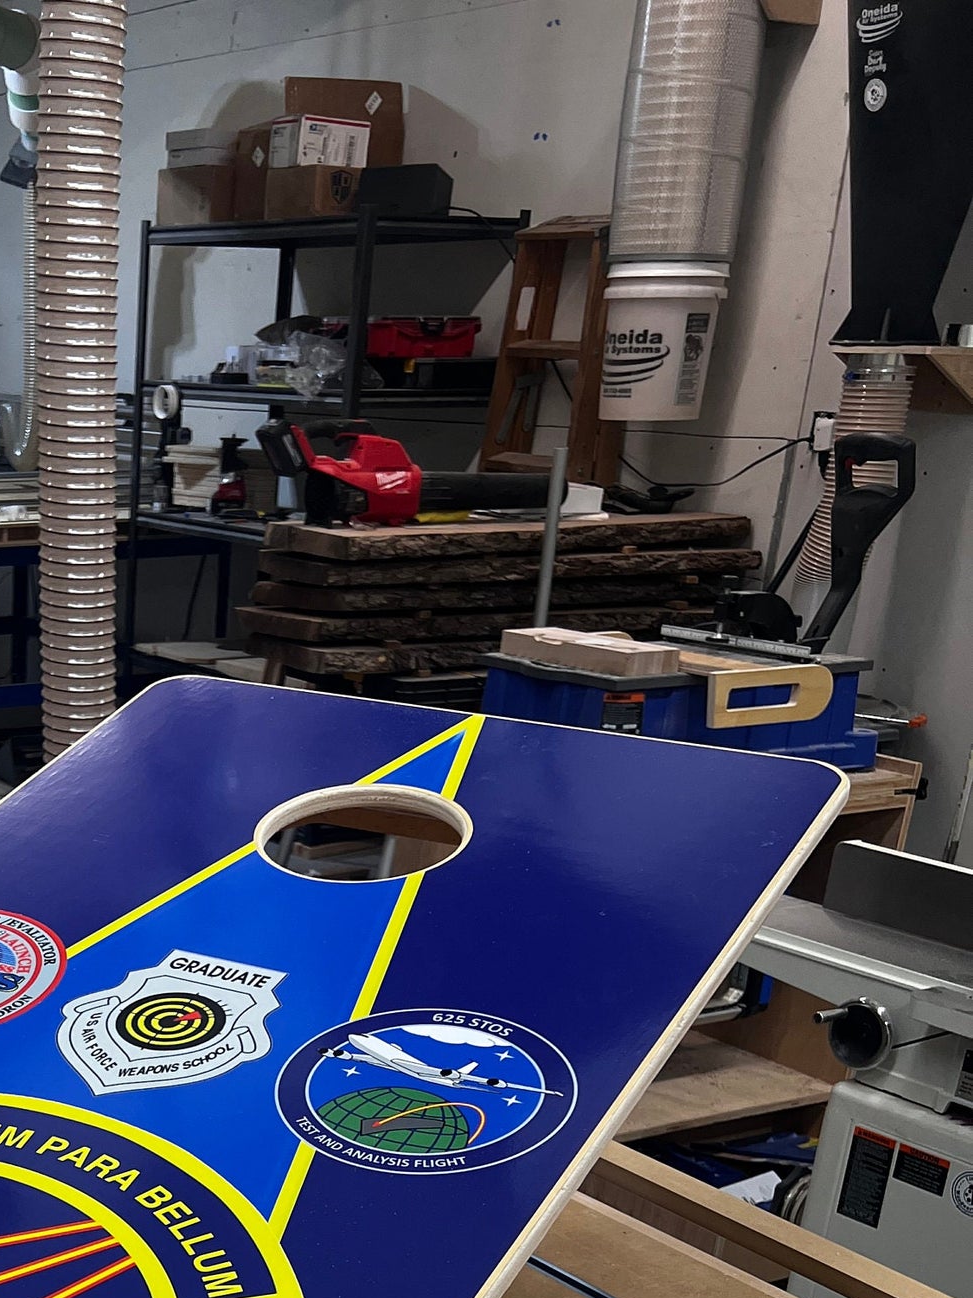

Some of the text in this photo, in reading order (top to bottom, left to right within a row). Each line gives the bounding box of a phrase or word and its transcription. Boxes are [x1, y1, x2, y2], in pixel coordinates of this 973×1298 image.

[861, 3, 898, 19] Oneida
[870, 12, 898, 23] Systems
[605, 329, 663, 345] neida
[611, 345, 662, 356] Systems
[169, 957, 272, 989] GRADUATE
[432, 1013, 514, 1038] 625 STOS
[81, 1012, 118, 1072] US AIR FORCE
[118, 1043, 235, 1078] WEAPONS SCHOOL
[295, 1115, 467, 1169] TEST AND ANALYSIS FLIGHT
[36, 1134, 145, 1193] PARA
